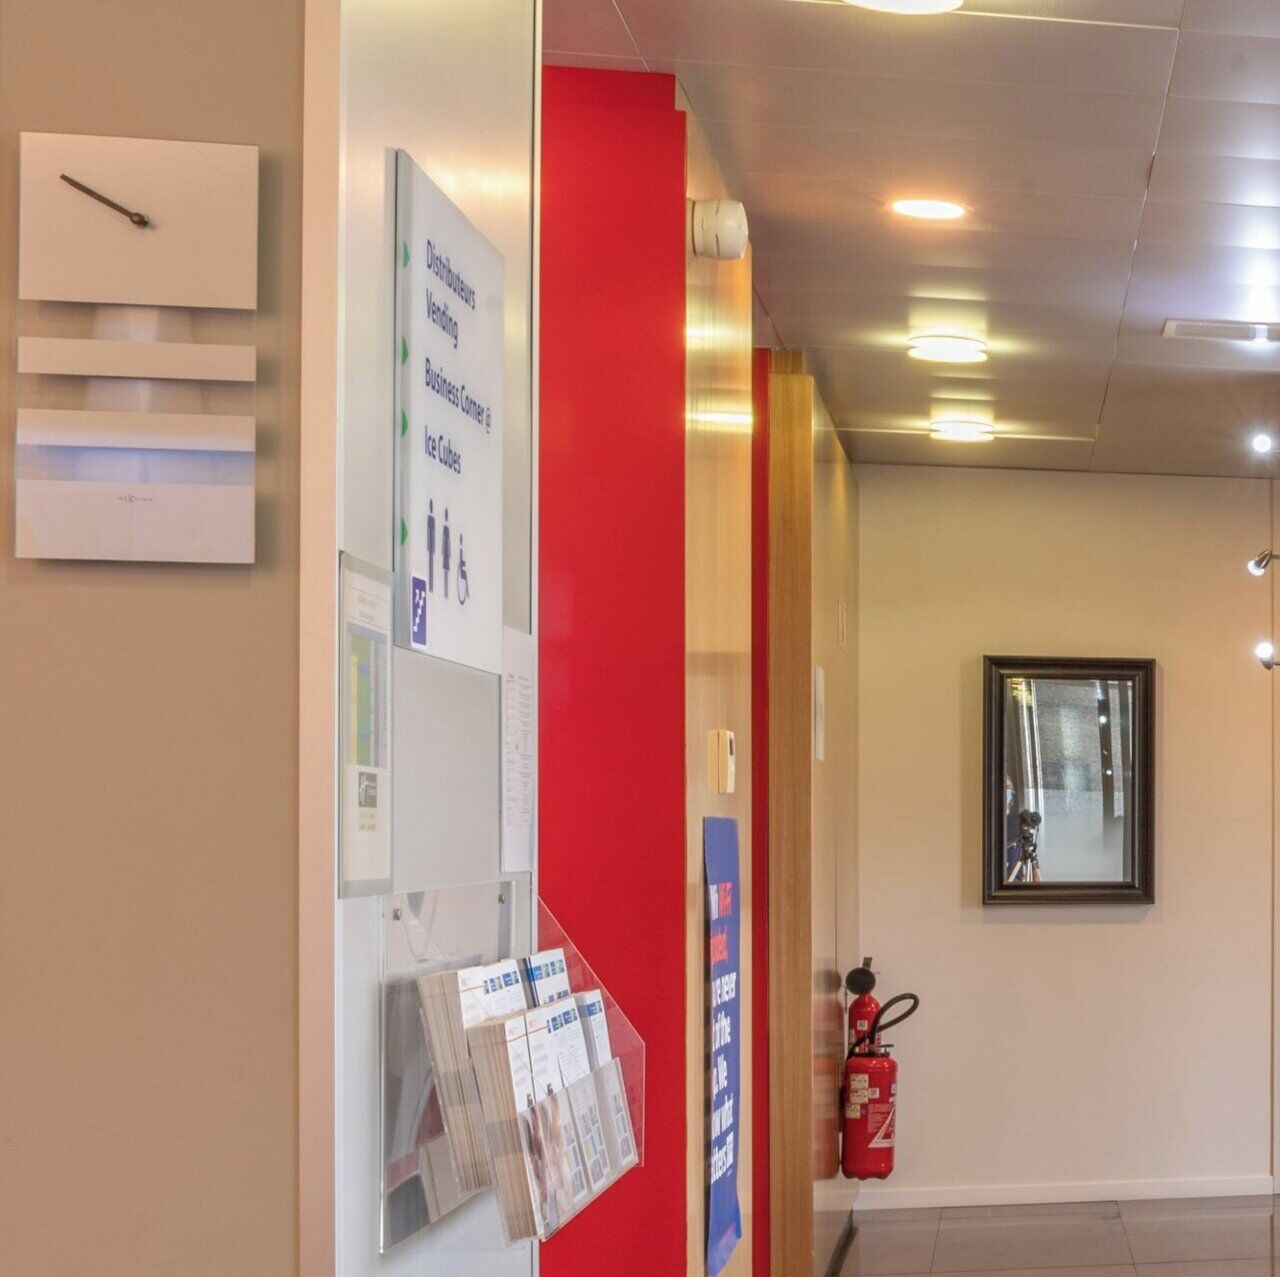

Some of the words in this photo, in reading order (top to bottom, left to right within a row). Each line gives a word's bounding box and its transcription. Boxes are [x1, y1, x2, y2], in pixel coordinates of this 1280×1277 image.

[425, 238, 476, 311] Distributeurs
[425, 287, 459, 350] Vending
[424, 356, 459, 409] Business
[460, 384, 484, 427] Corner
[424, 425, 437, 461] Ice
[438, 434, 462, 475] Cubes
